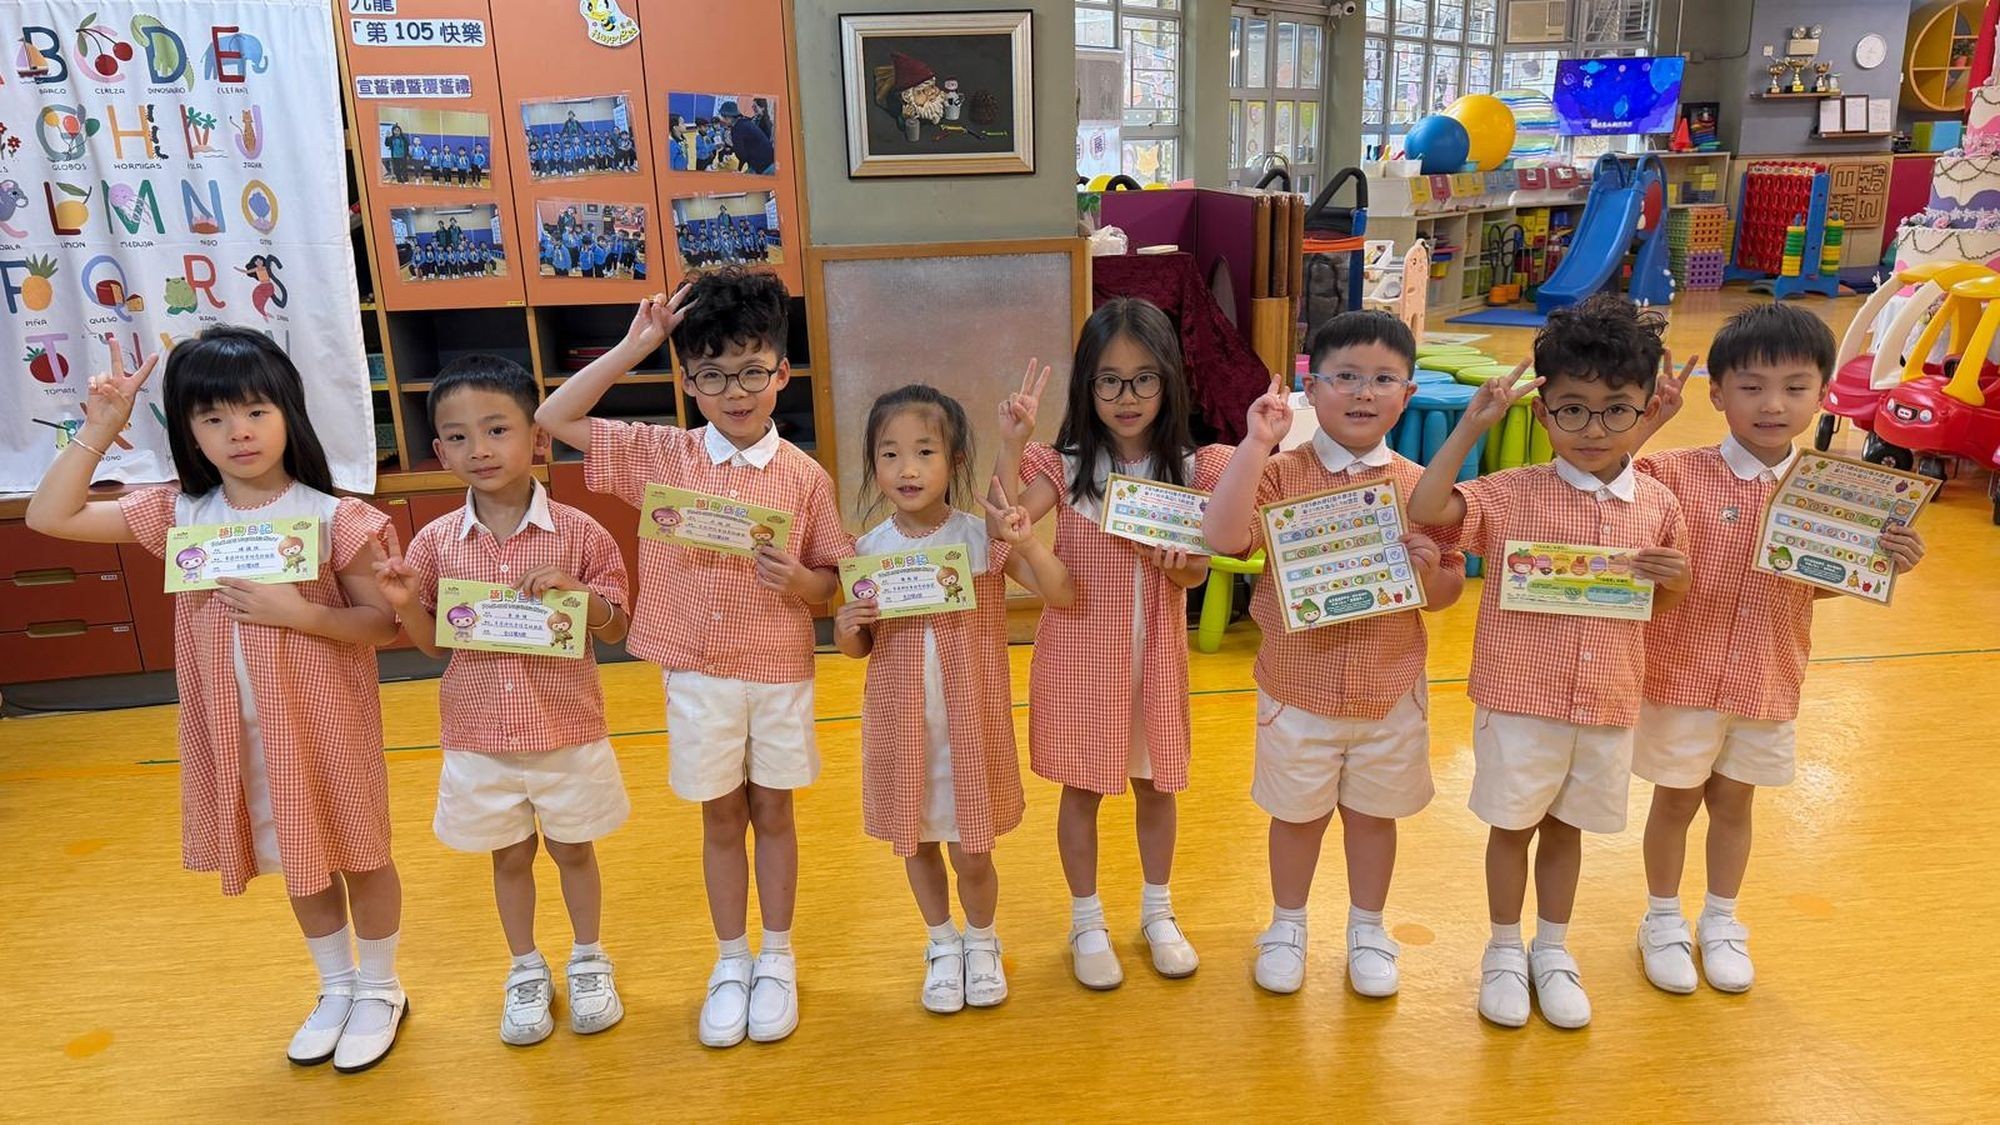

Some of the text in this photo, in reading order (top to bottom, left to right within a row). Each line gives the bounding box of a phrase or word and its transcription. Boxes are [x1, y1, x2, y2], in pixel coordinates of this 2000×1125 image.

[395, 22, 434, 41] 105
[440, 22, 484, 43] 快樂
[22, 26, 68, 84] B
[142, 26, 187, 84] D
[211, 26, 246, 84] E
[107, 104, 155, 160] H
[52, 163, 88, 171] GLOBOS
[43, 179, 279, 235] L M N O
[120, 240, 154, 248] MEDUSA
[81, 255, 133, 322] Q
[183, 254, 226, 310] R
[25, 319, 48, 327] PIÑA
[89, 316, 118, 325] QUESO
[25, 333, 69, 384] T
[44, 387, 77, 395] TOMATE
